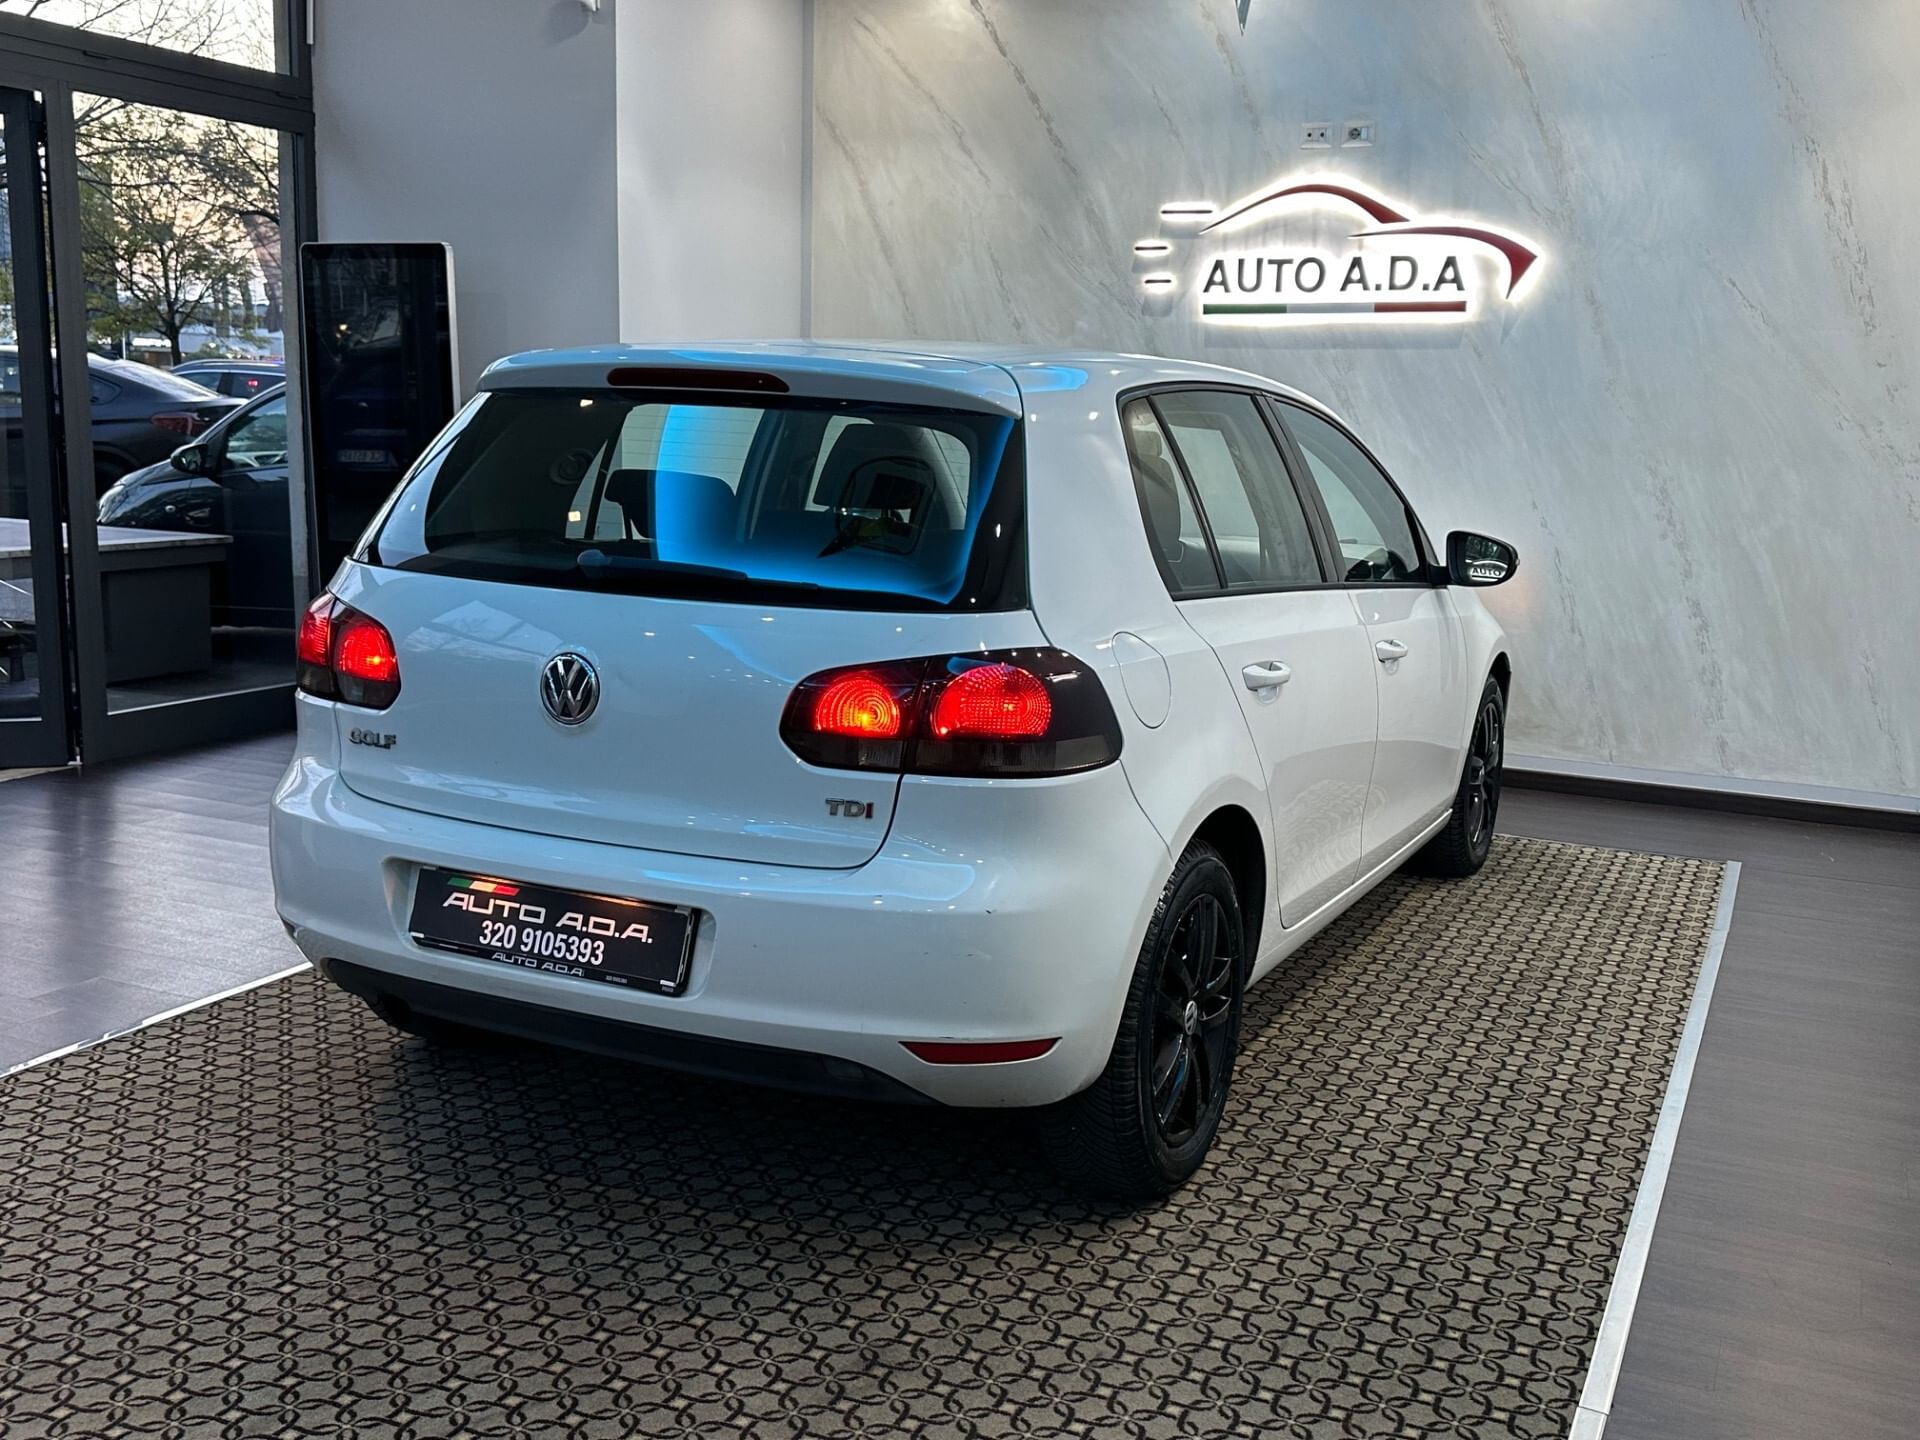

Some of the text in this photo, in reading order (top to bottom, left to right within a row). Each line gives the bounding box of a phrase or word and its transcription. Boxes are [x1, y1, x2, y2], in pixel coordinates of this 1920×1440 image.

[1203, 255, 1465, 293] AUTO A.D.A
[1472, 567, 1501, 576] AUTO
[825, 798, 874, 819] TDI
[442, 891, 653, 944] AUTO A.D.A.
[479, 920, 605, 967] 320 9105393
[491, 952, 537, 968] AUTO
